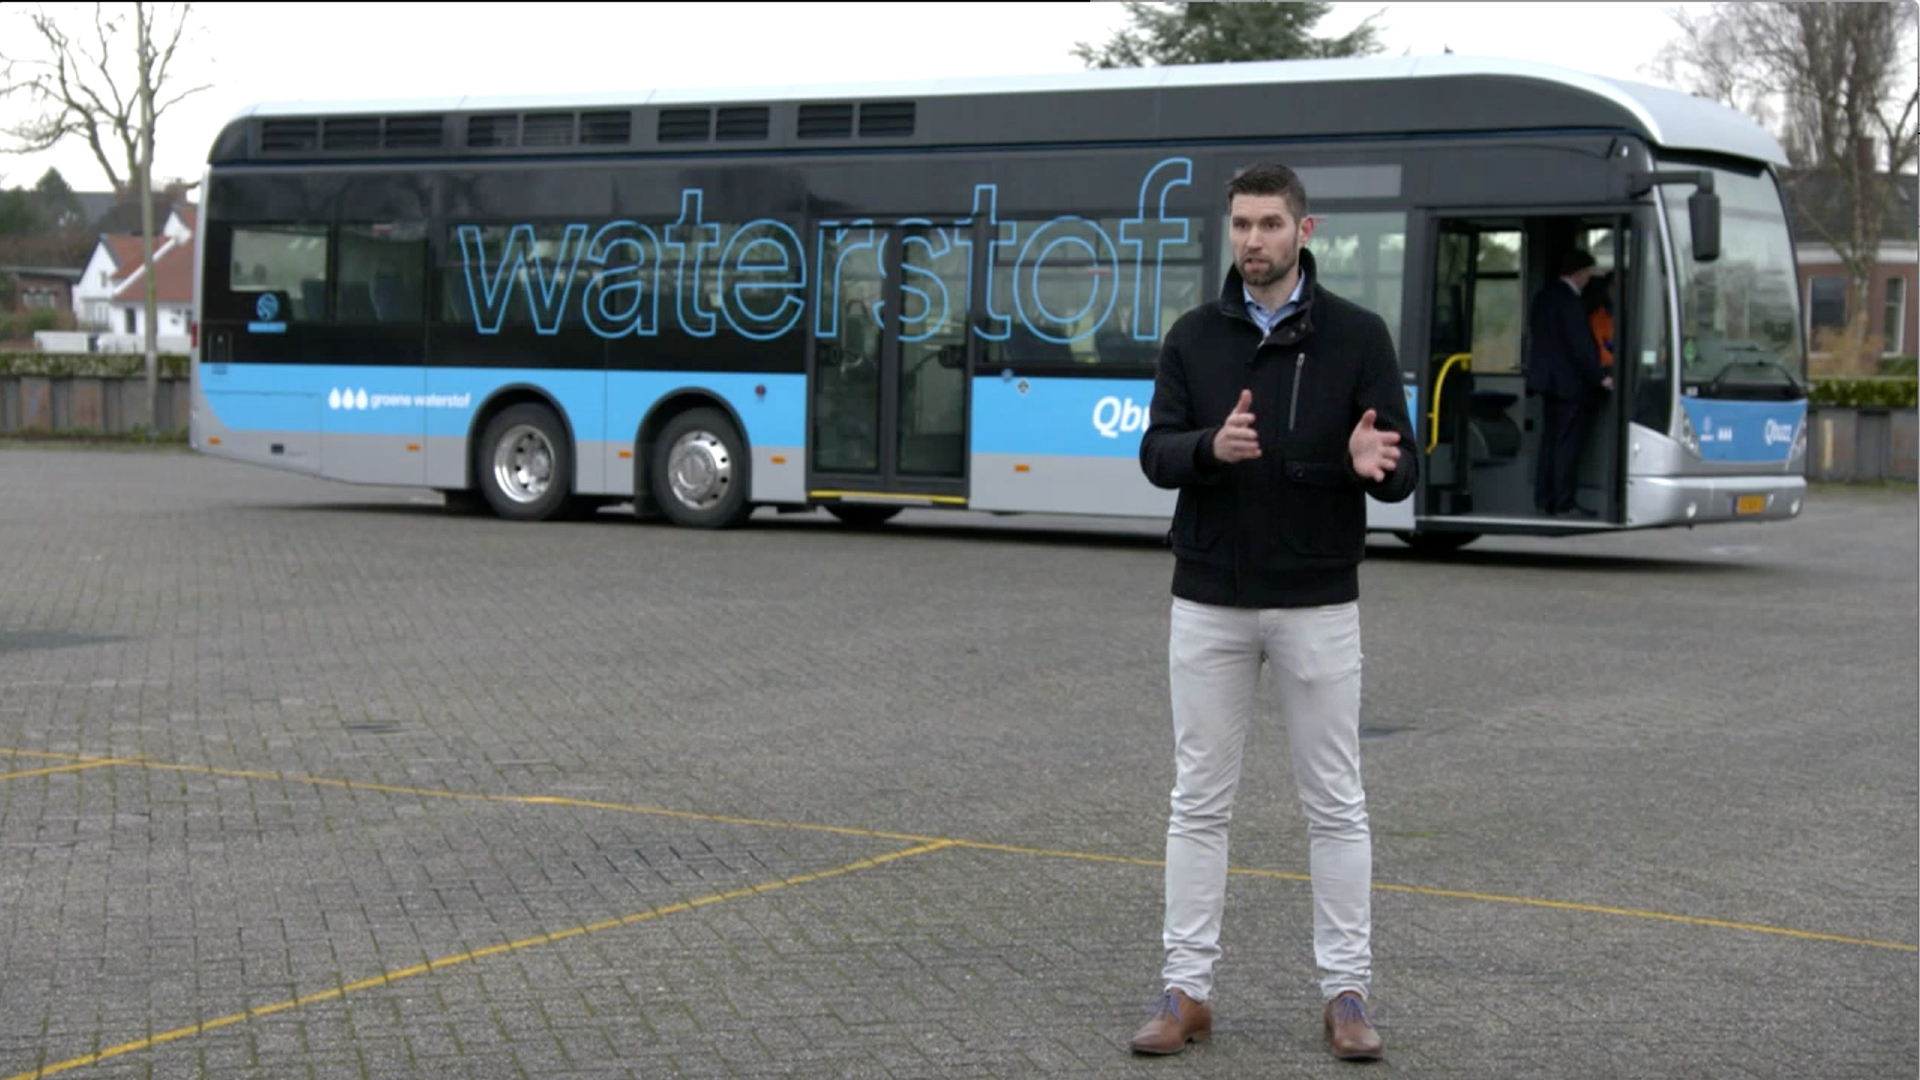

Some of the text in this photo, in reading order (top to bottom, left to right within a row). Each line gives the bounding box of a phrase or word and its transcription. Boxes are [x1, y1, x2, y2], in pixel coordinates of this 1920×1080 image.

[457, 157, 1192, 343] waterstof
[370, 391, 470, 410] groene waterstof
